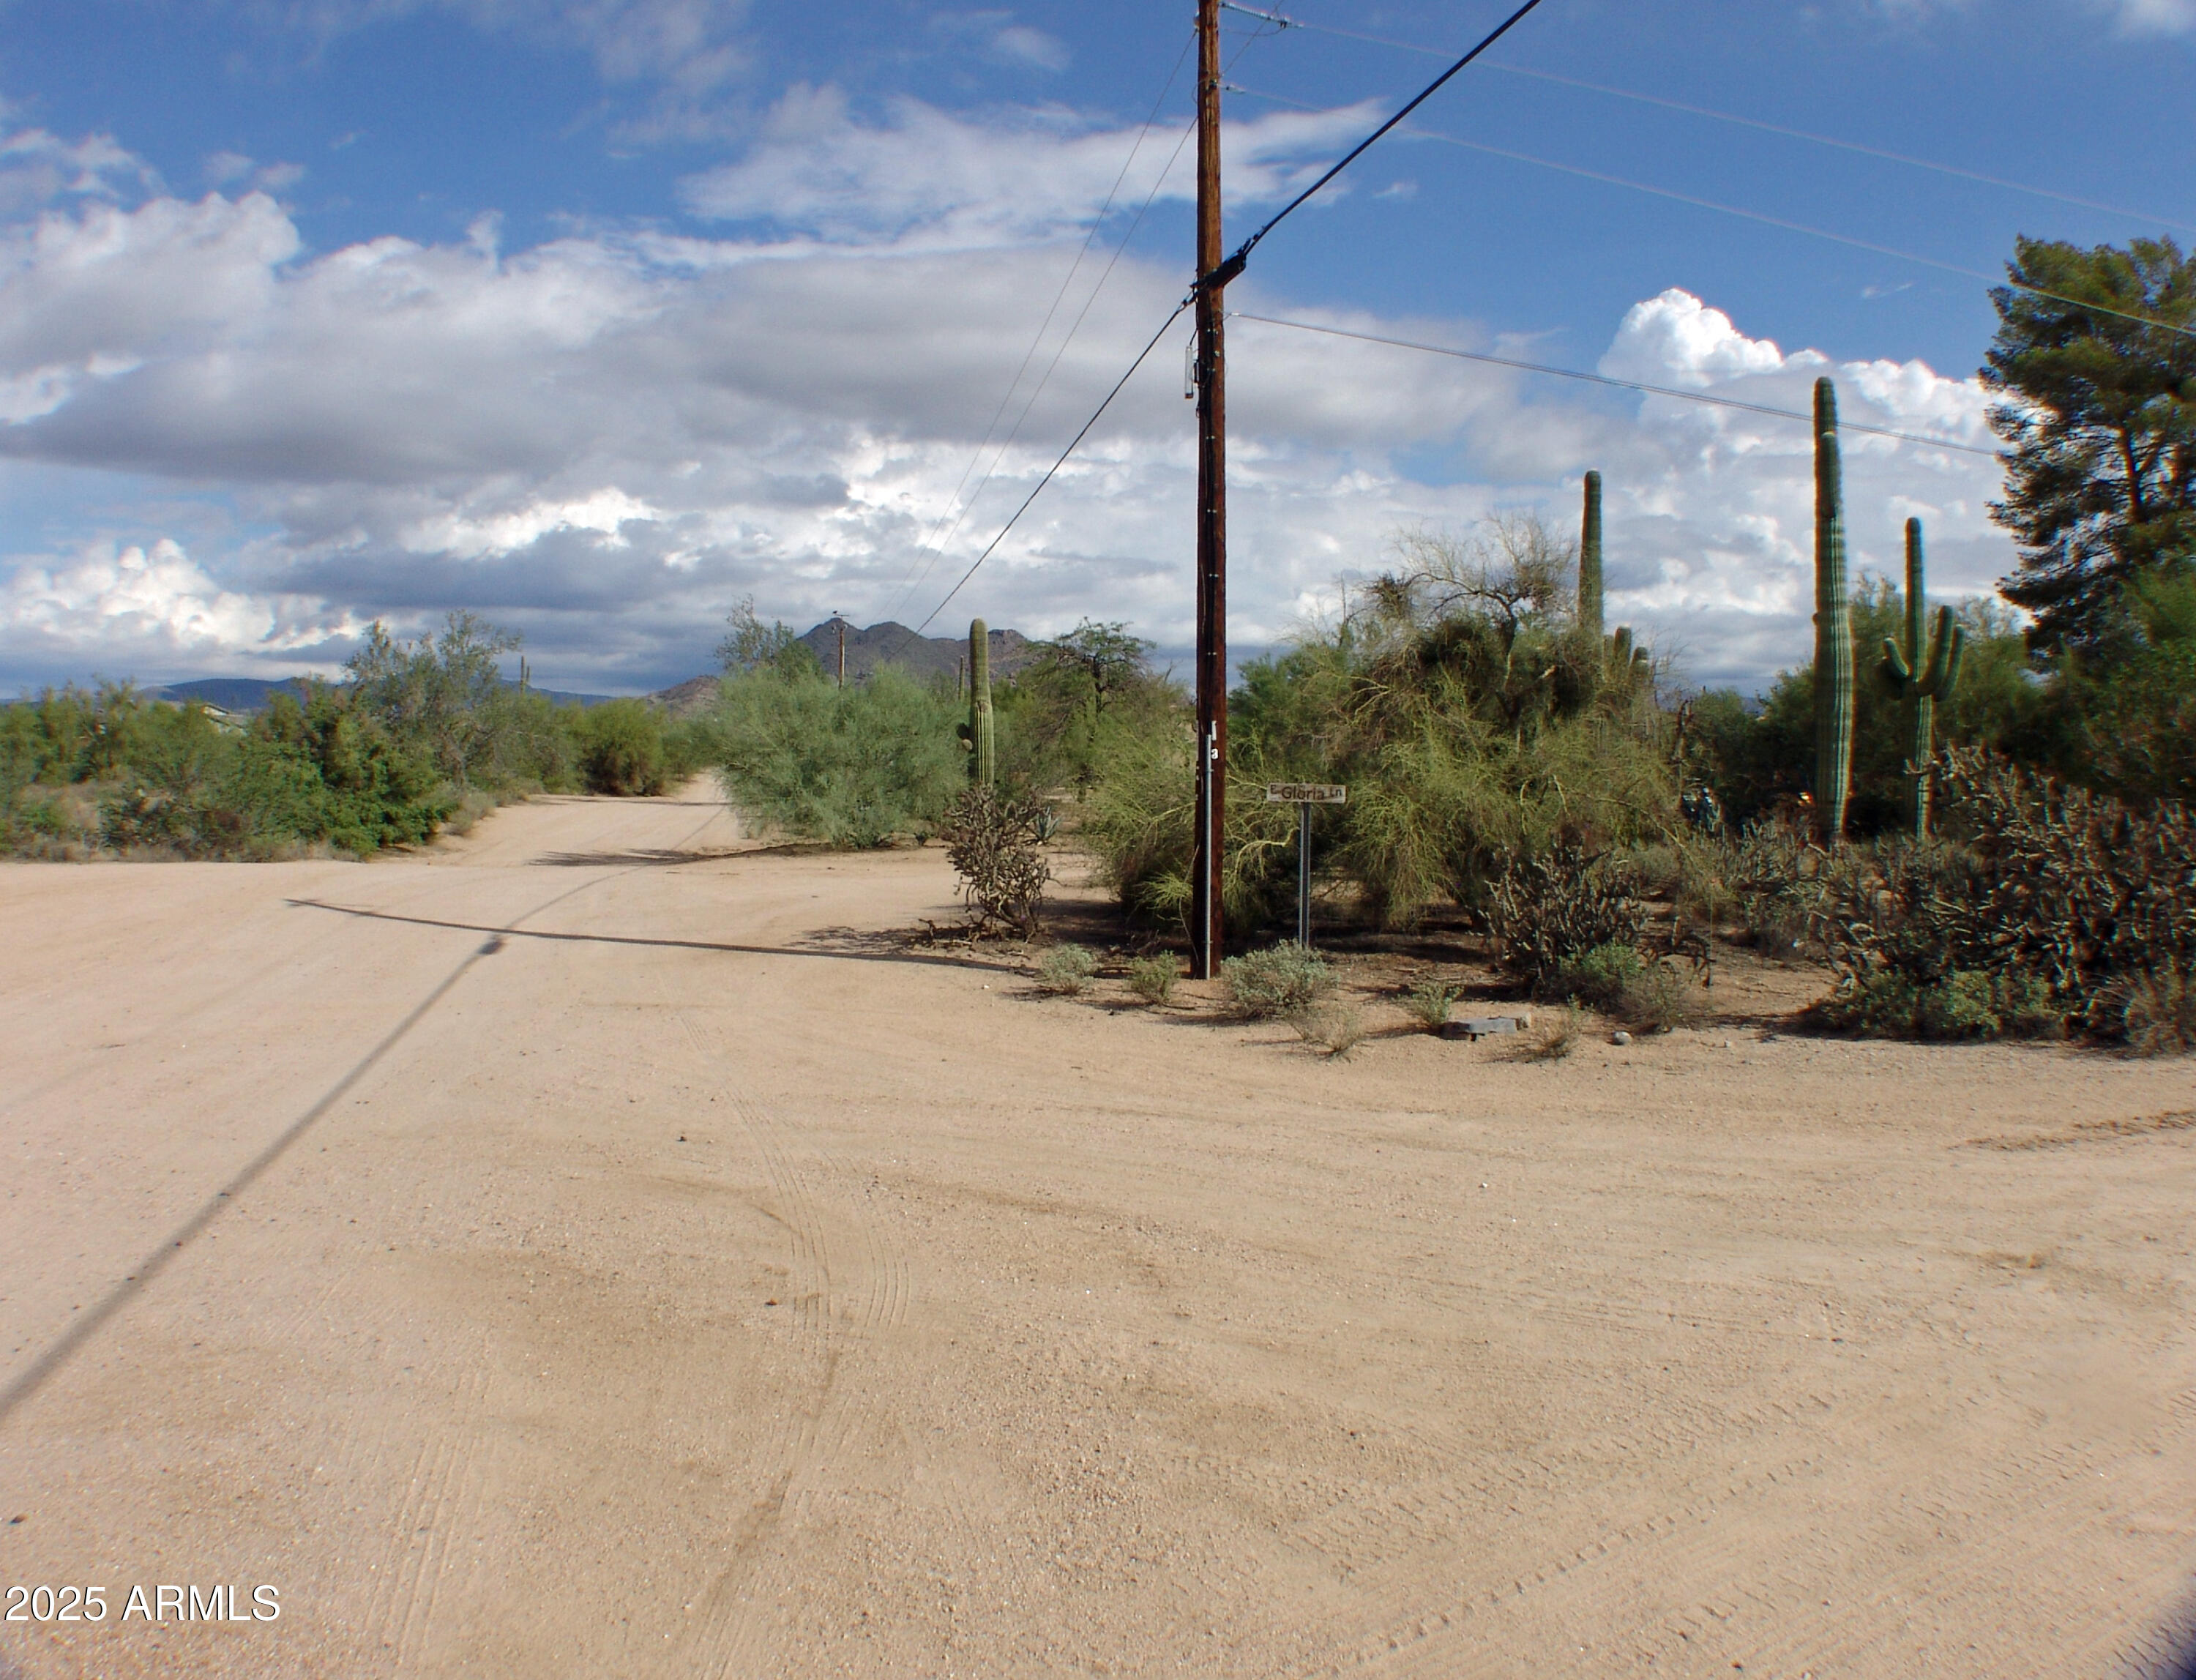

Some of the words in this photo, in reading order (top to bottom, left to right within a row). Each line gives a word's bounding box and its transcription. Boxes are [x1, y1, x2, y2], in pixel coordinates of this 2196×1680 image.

[1270, 784, 1277, 794] E
[1281, 785, 1325, 800] Gloria
[1329, 788, 1342, 798] Ln
